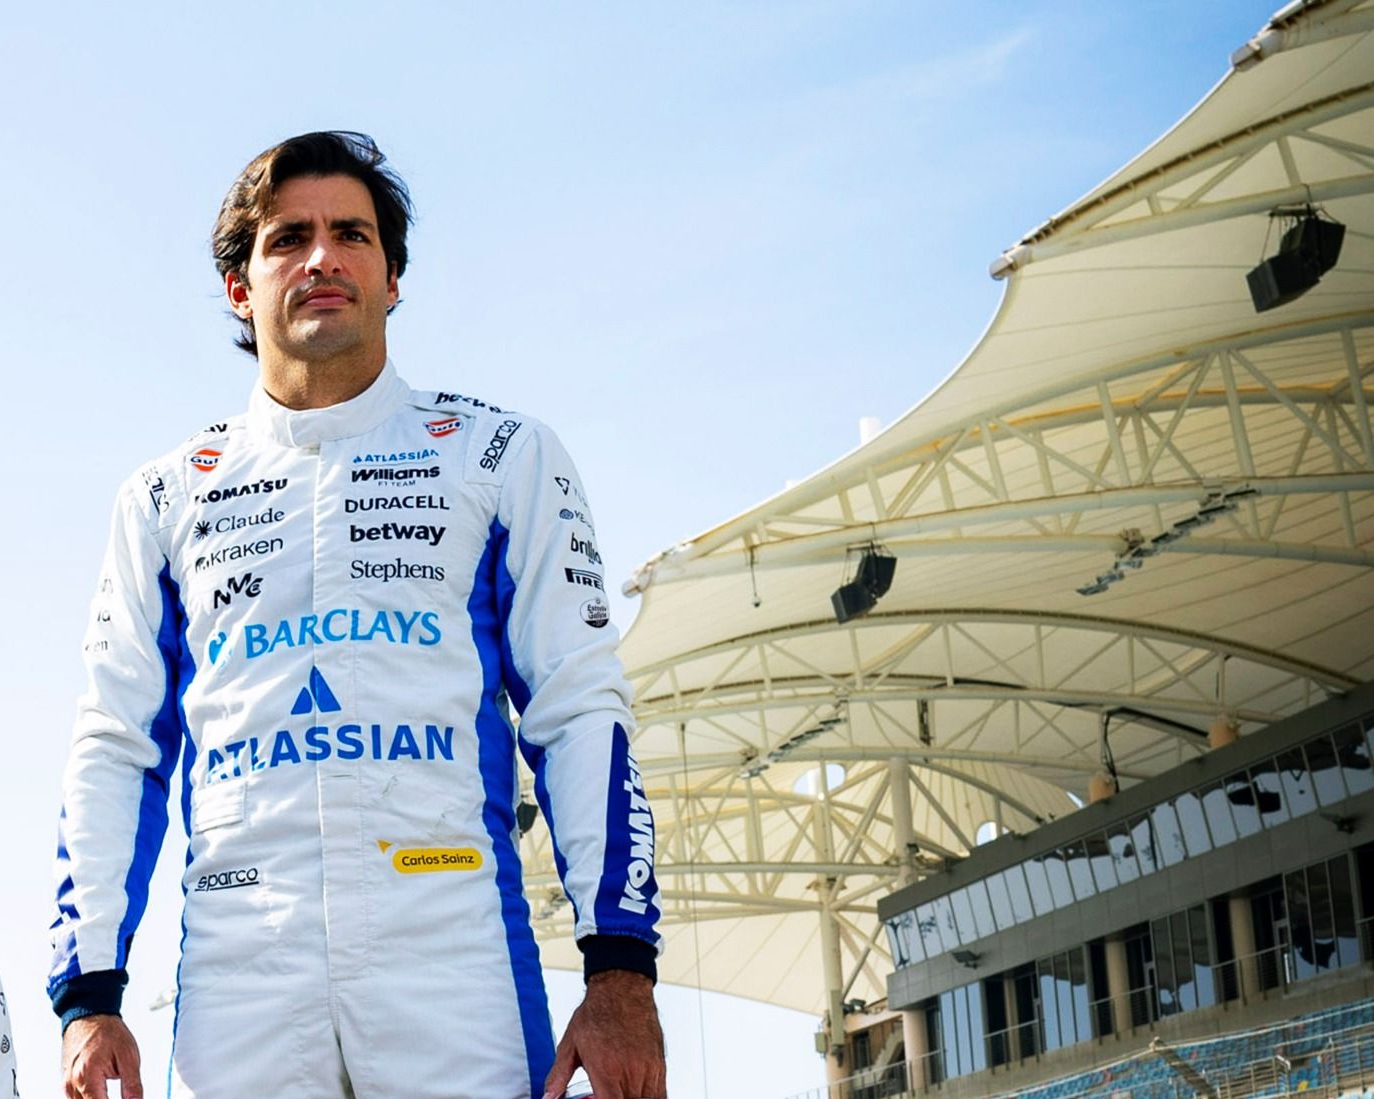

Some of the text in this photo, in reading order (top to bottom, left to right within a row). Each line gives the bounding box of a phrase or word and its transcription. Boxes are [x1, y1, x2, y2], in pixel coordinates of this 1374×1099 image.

[479, 419, 522, 472] sparco
[351, 466, 440, 482] Williams
[345, 495, 450, 513] DURACELL
[215, 508, 285, 533] Claude
[350, 522, 446, 546] betway
[350, 557, 445, 582] Stephens
[244, 609, 441, 659] BARCLAYS
[207, 724, 454, 784] ATLASSIAN
[402, 853, 474, 867] Carlos Sainz
[196, 867, 259, 891] sparco
